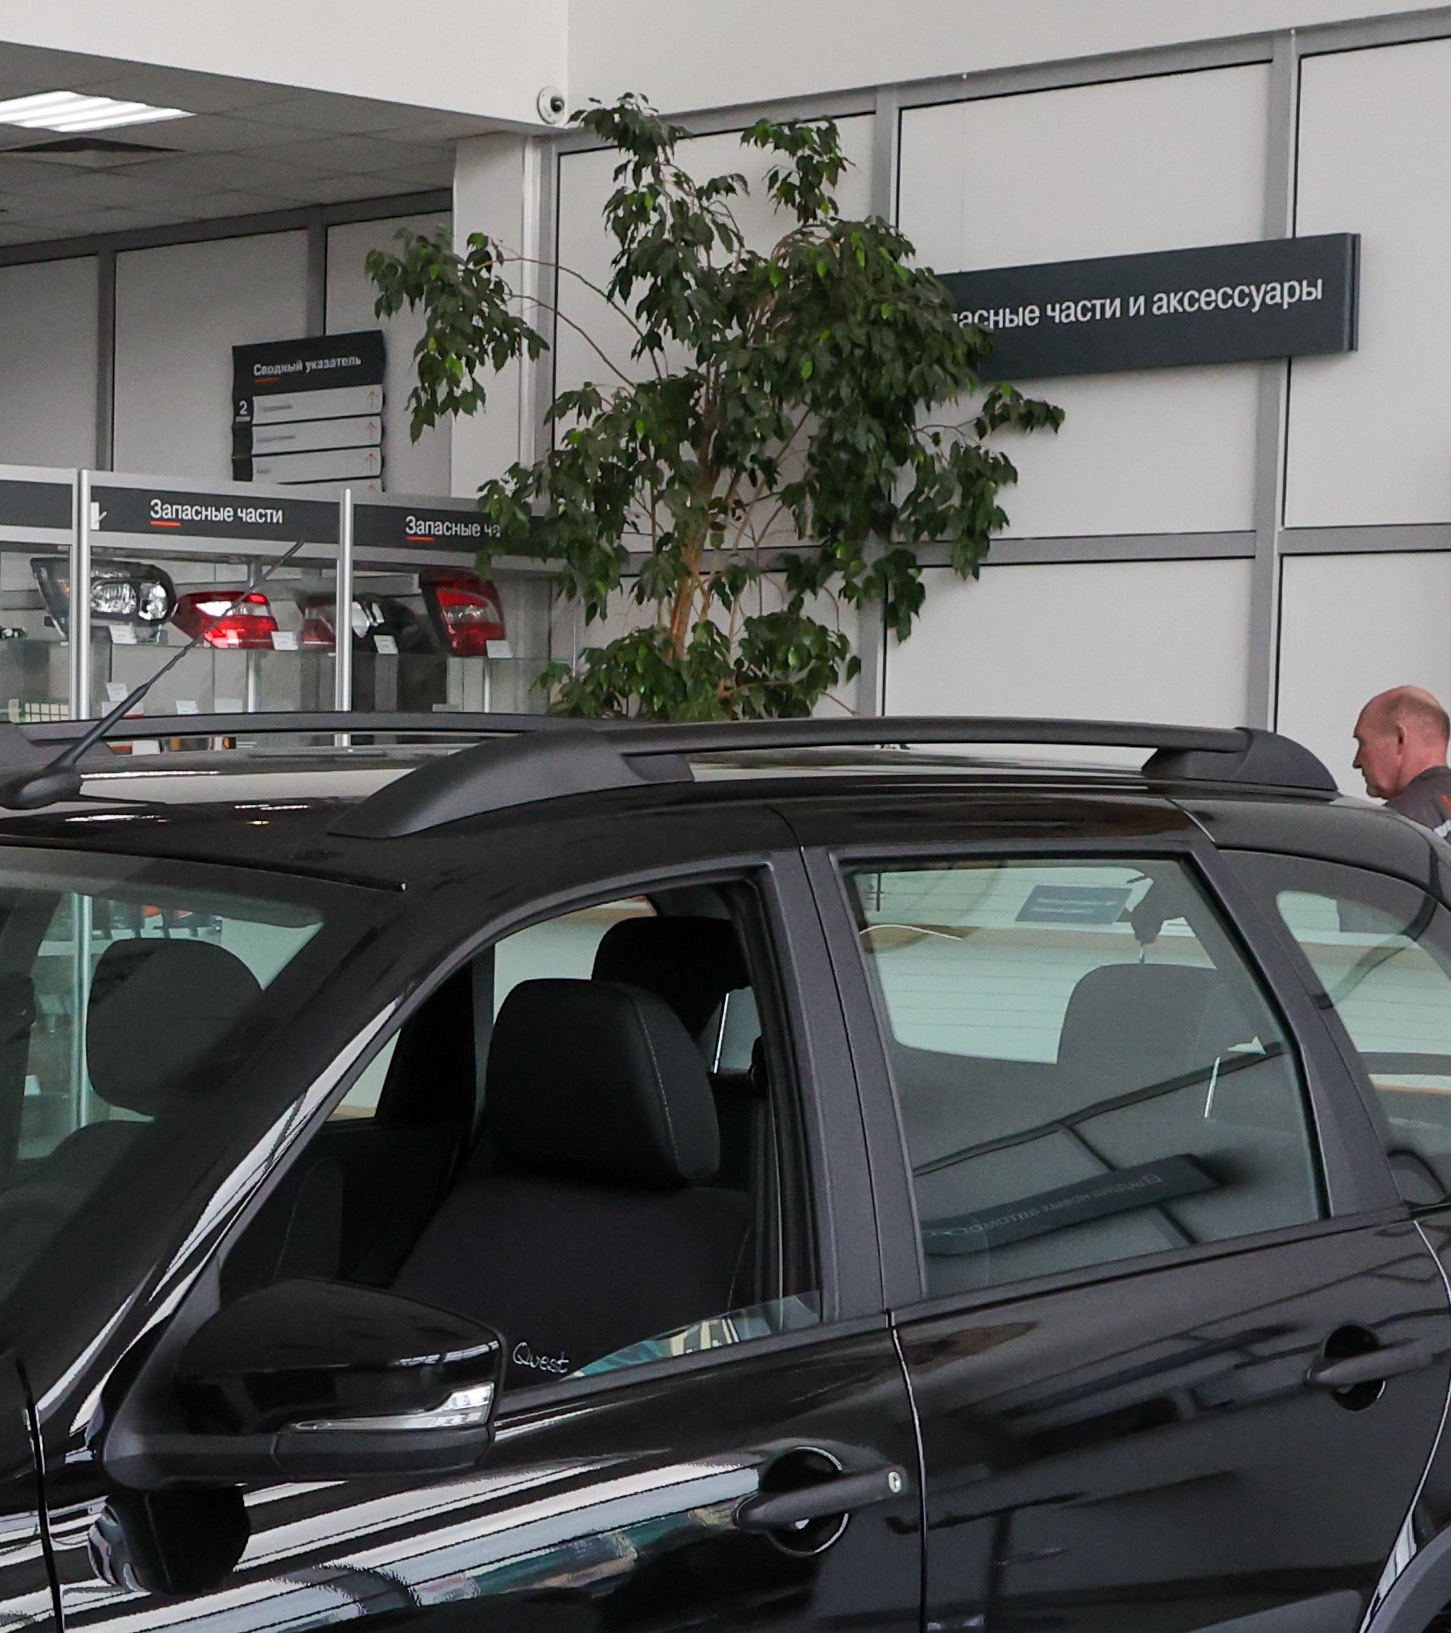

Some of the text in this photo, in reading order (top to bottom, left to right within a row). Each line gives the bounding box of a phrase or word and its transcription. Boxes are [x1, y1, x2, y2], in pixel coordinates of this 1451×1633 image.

[1046, 297, 1122, 325] части
[1129, 295, 1145, 317] и
[1152, 278, 1324, 316] аксессуары
[253, 356, 362, 377] Сводный указатель
[239, 400, 248, 415] 2
[150, 499, 284, 525] Запасные части
[405, 515, 480, 538] Запасные
